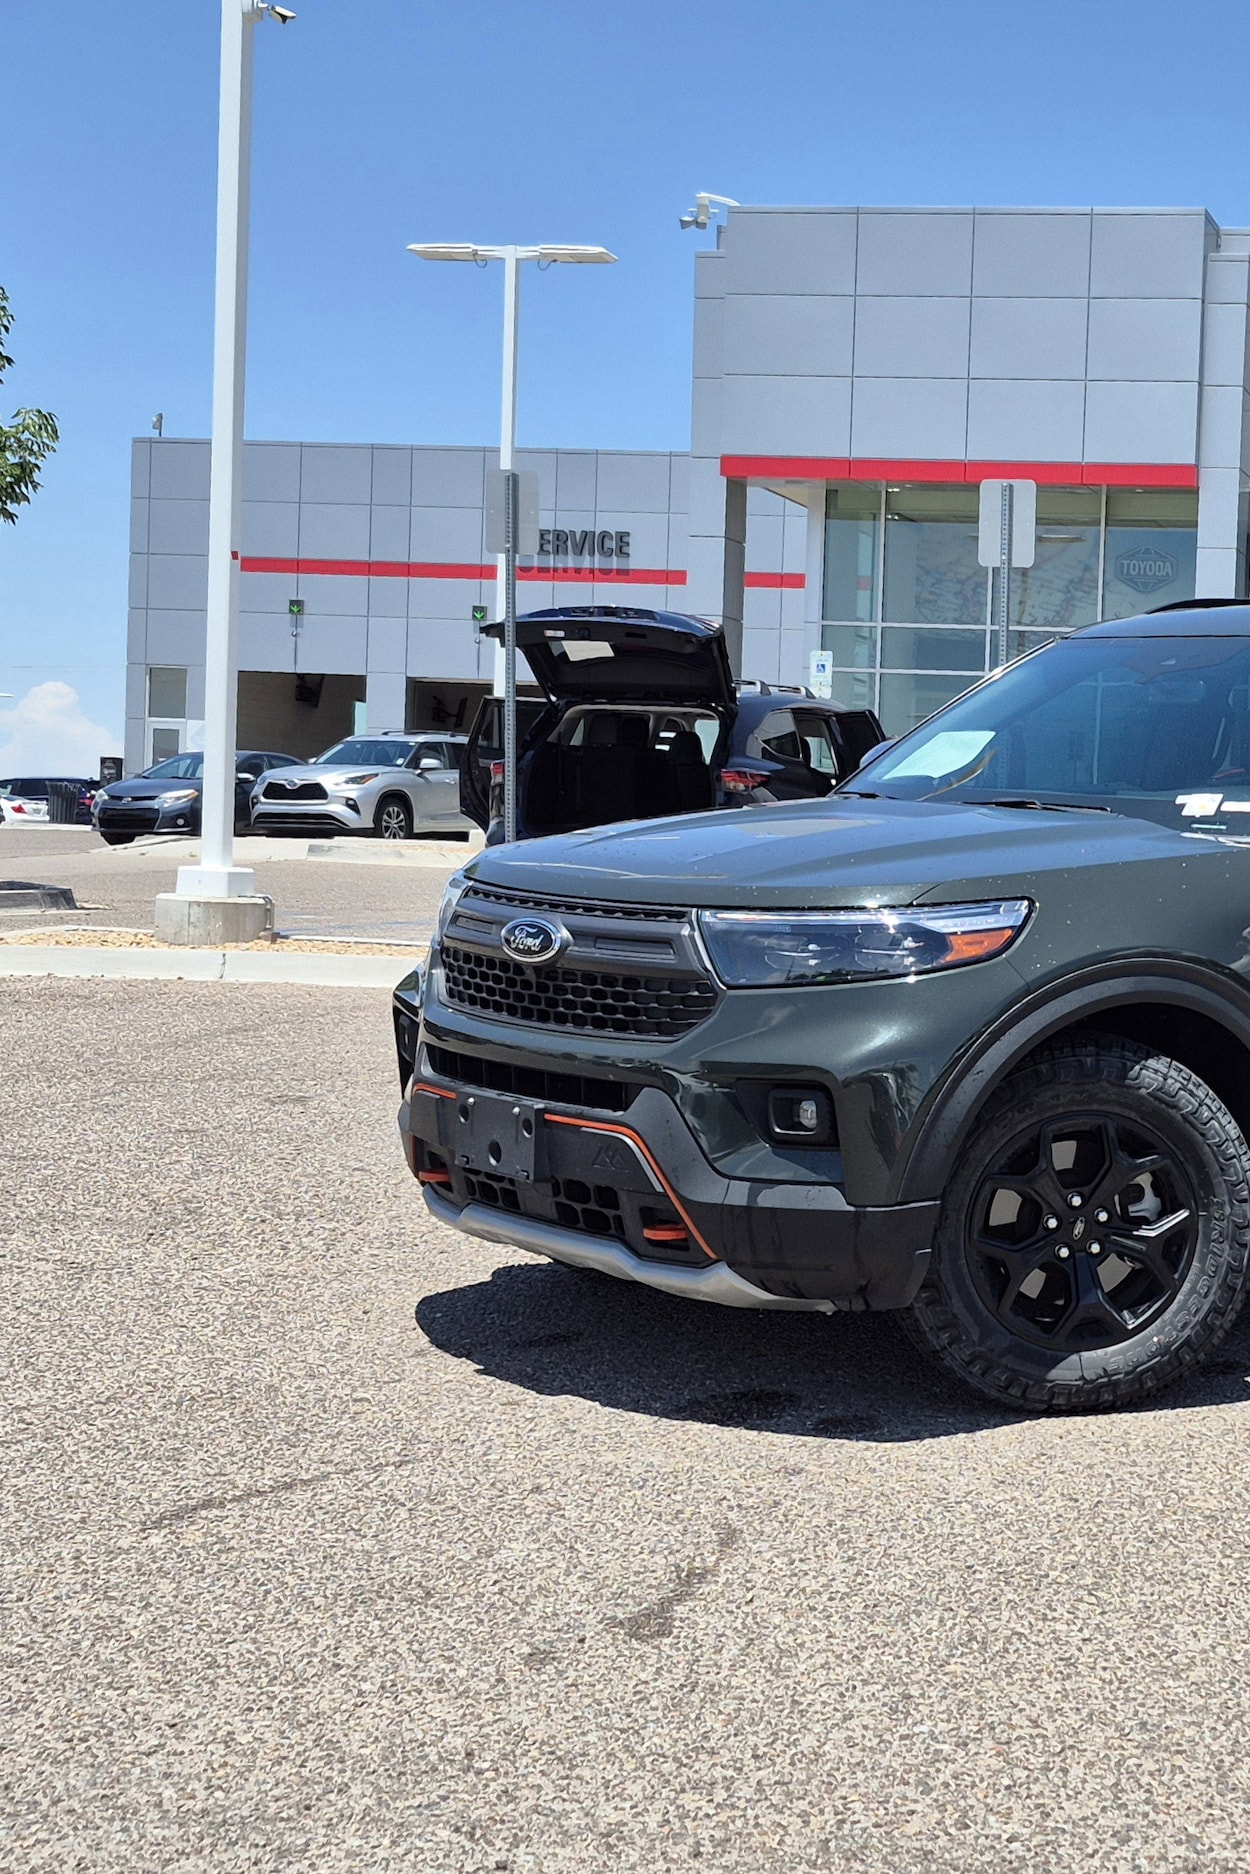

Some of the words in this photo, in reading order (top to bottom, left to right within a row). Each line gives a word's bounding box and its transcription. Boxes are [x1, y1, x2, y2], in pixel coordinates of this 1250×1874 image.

[538, 529, 630, 558] ERVICE
[1121, 560, 1172, 577] TOYODA
[510, 925, 544, 951] Ford
